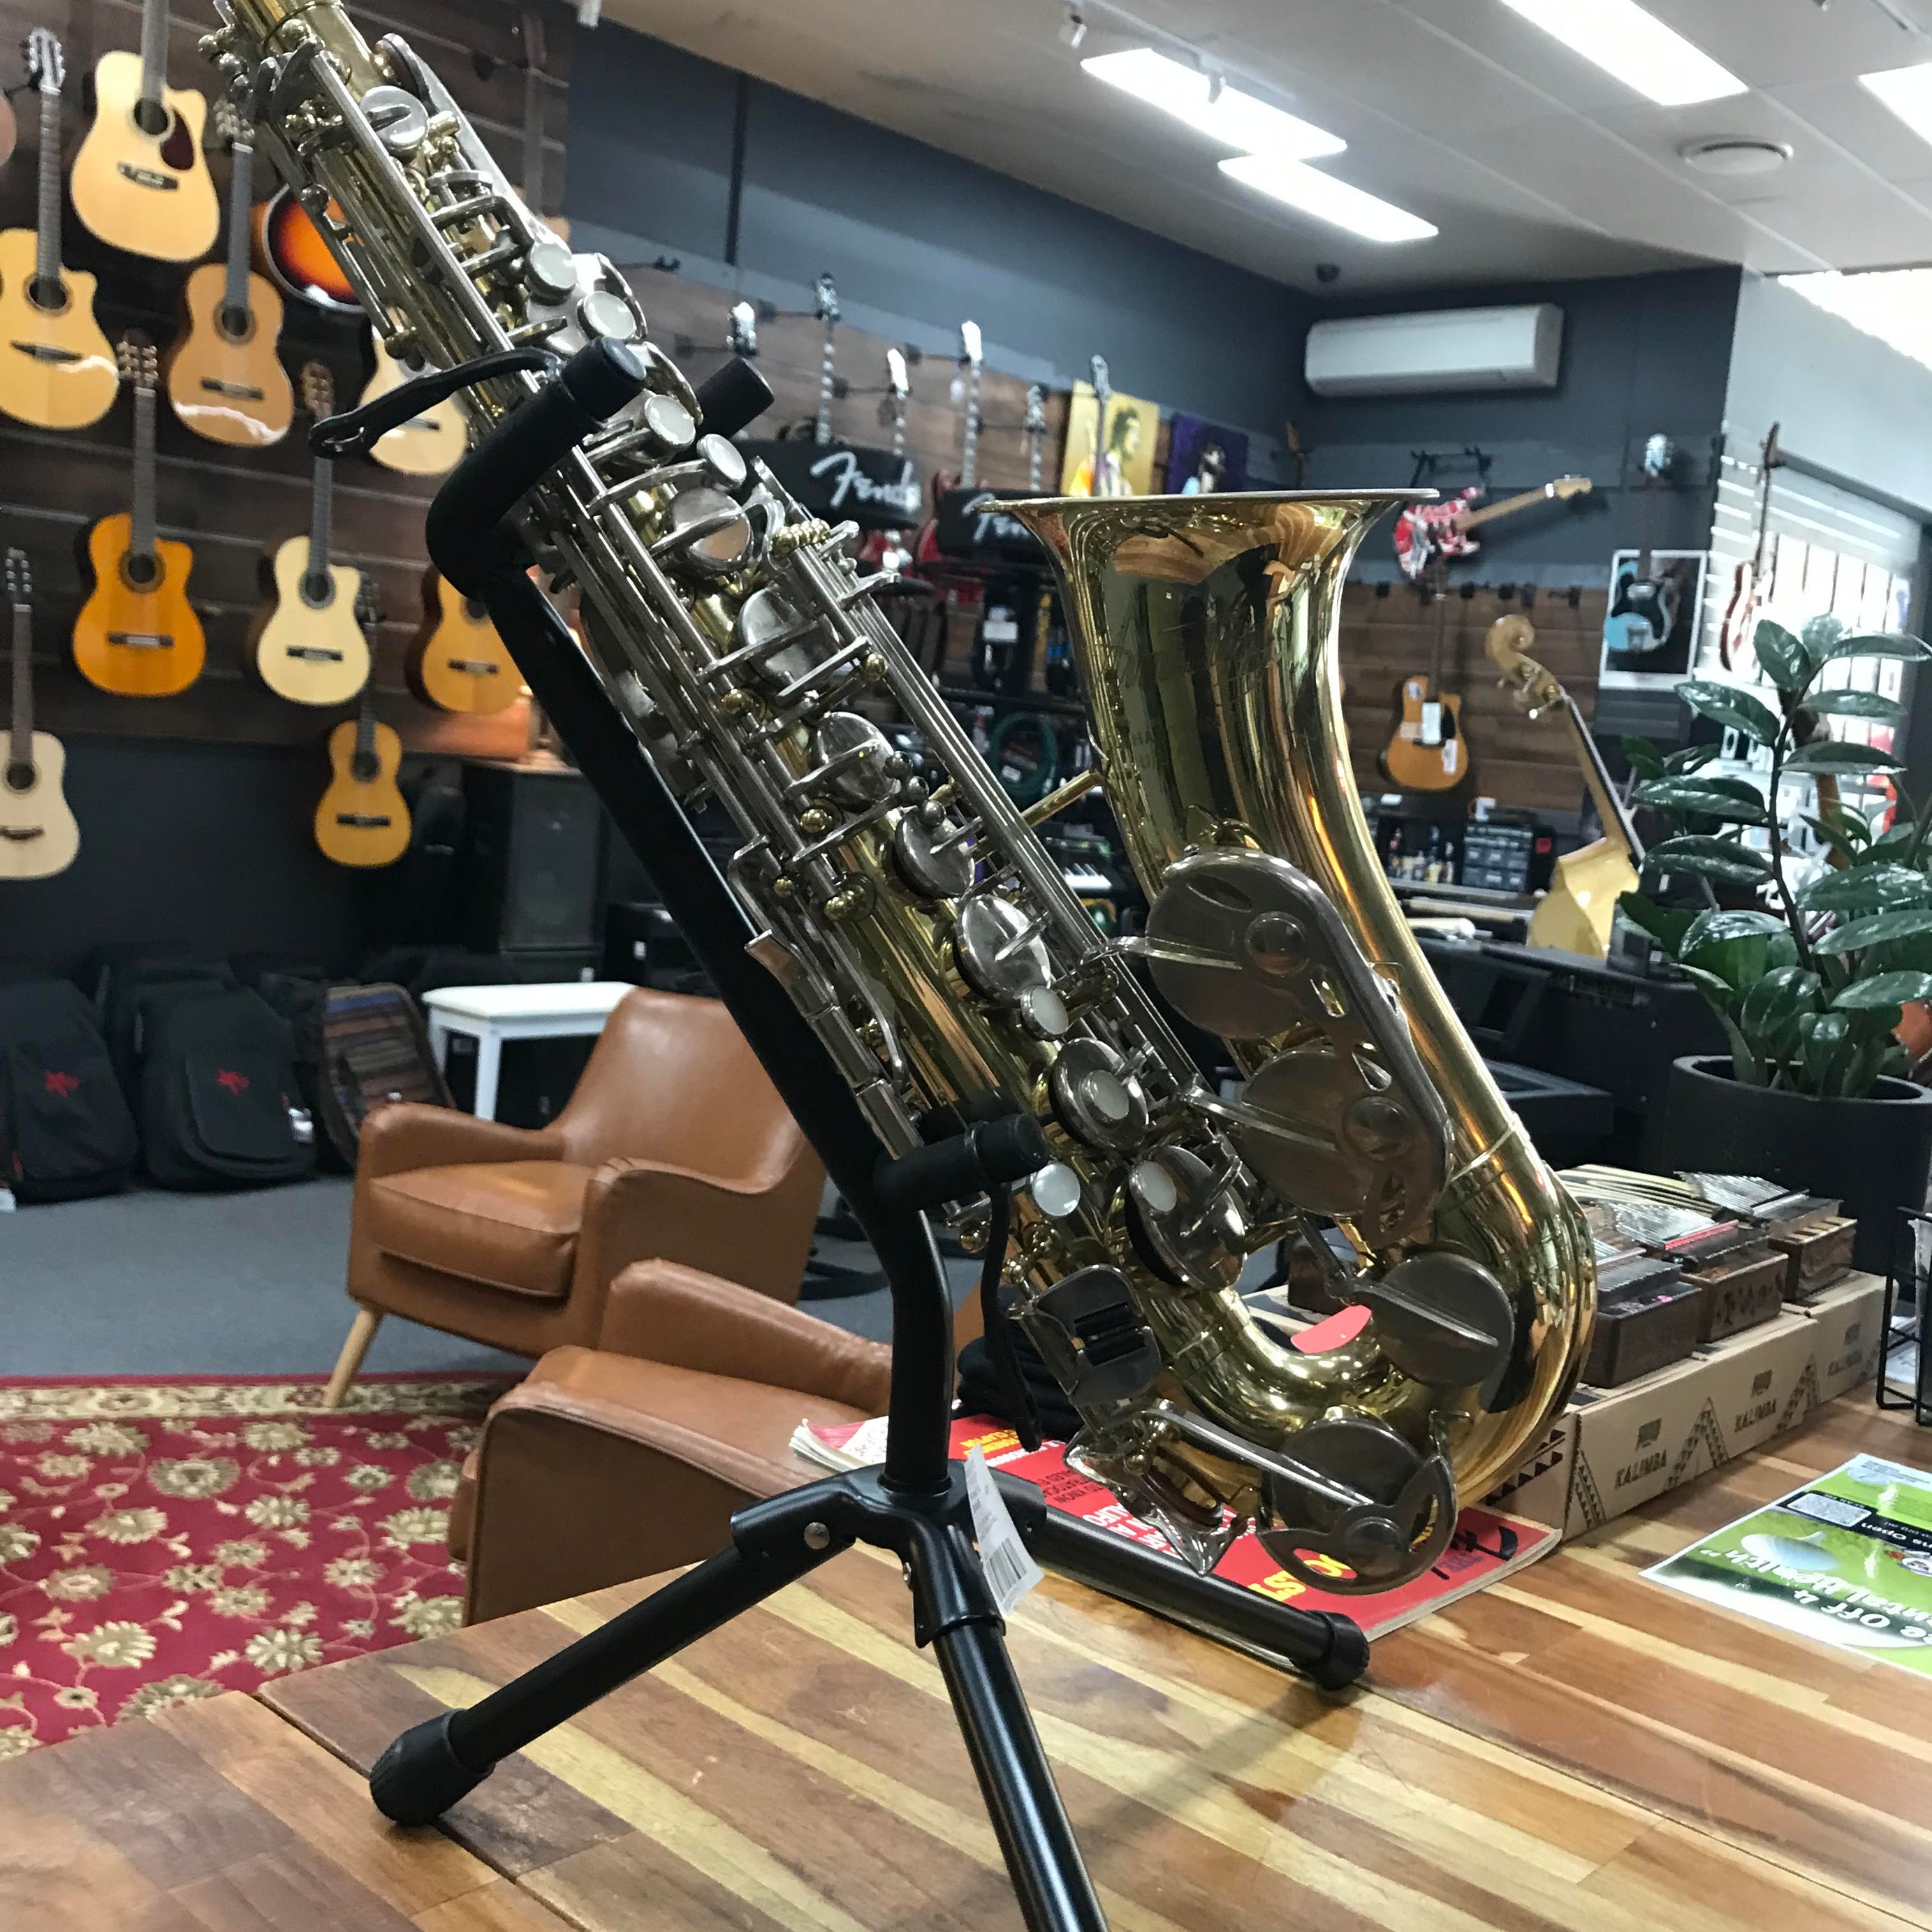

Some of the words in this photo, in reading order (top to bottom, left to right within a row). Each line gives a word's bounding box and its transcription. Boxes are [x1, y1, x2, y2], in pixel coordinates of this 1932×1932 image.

[1861, 1522, 1907, 1541] Open
[1793, 1589, 1820, 1604] 4
[1820, 1602, 1891, 1628] Off
